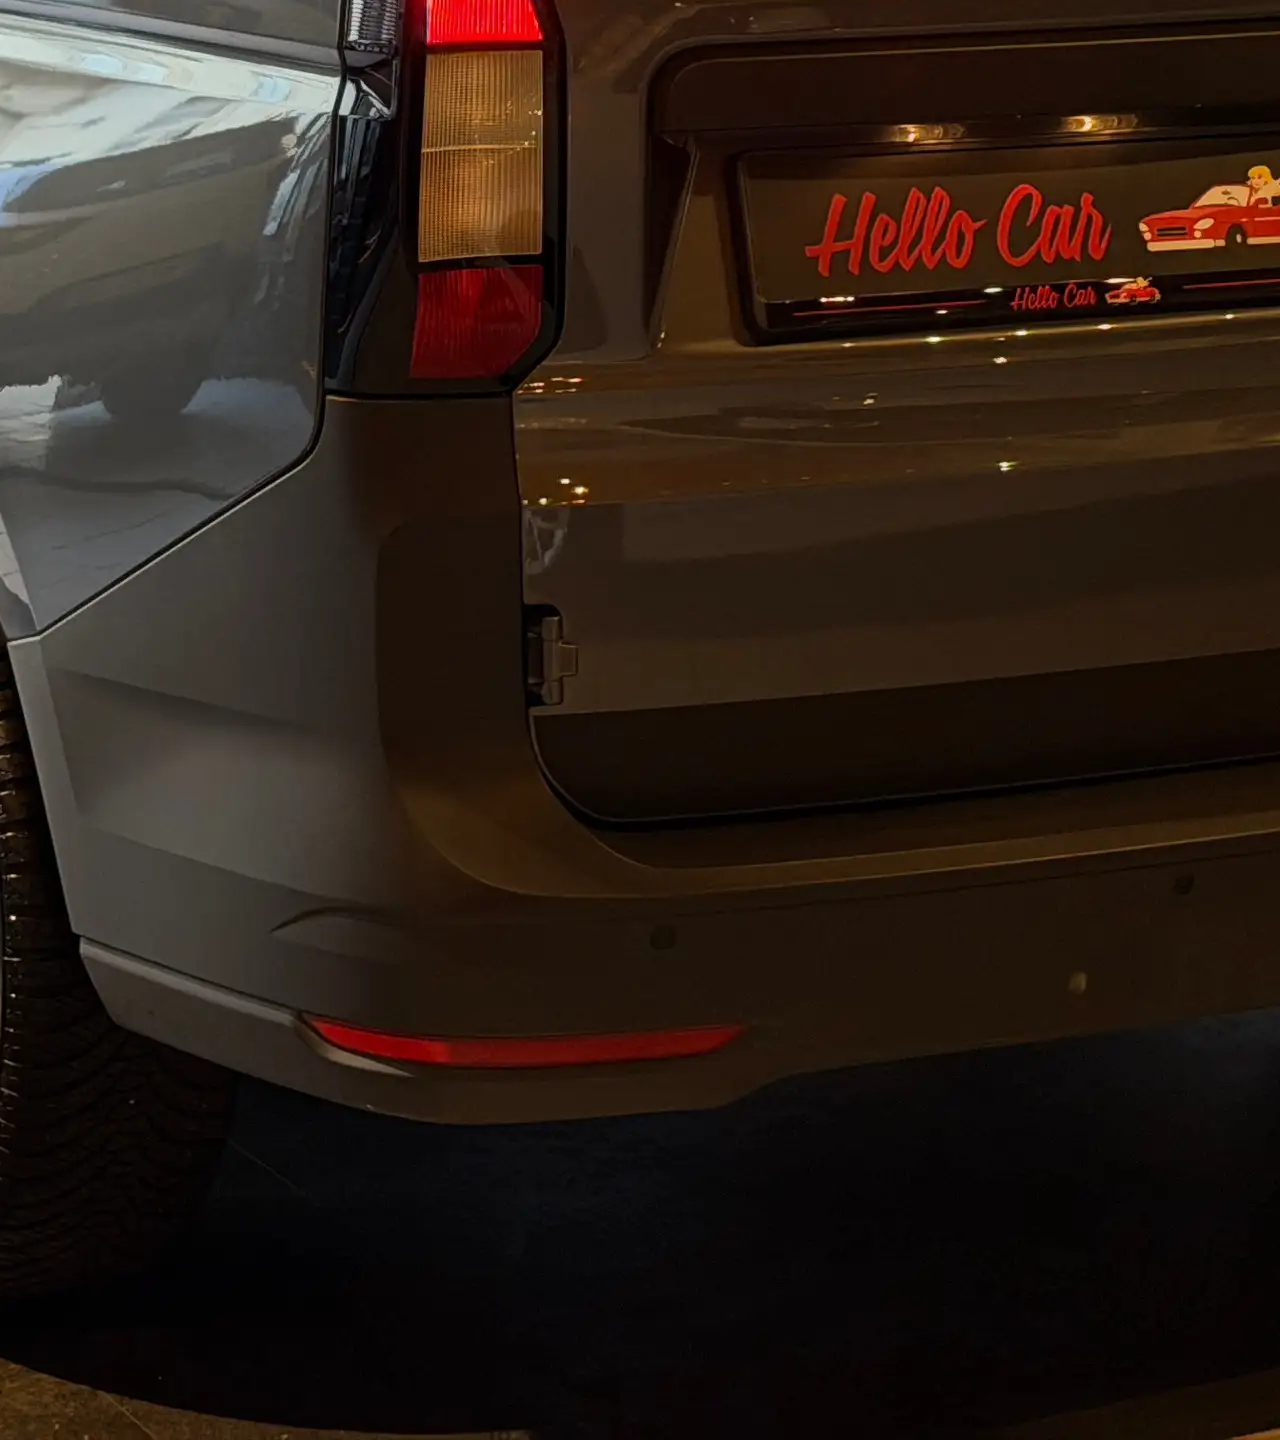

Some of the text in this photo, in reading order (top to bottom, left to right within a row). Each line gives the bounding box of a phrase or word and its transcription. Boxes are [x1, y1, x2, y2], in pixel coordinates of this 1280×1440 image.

[805, 183, 1112, 277] Hello Car
[1010, 282, 1097, 312] Hello Car
